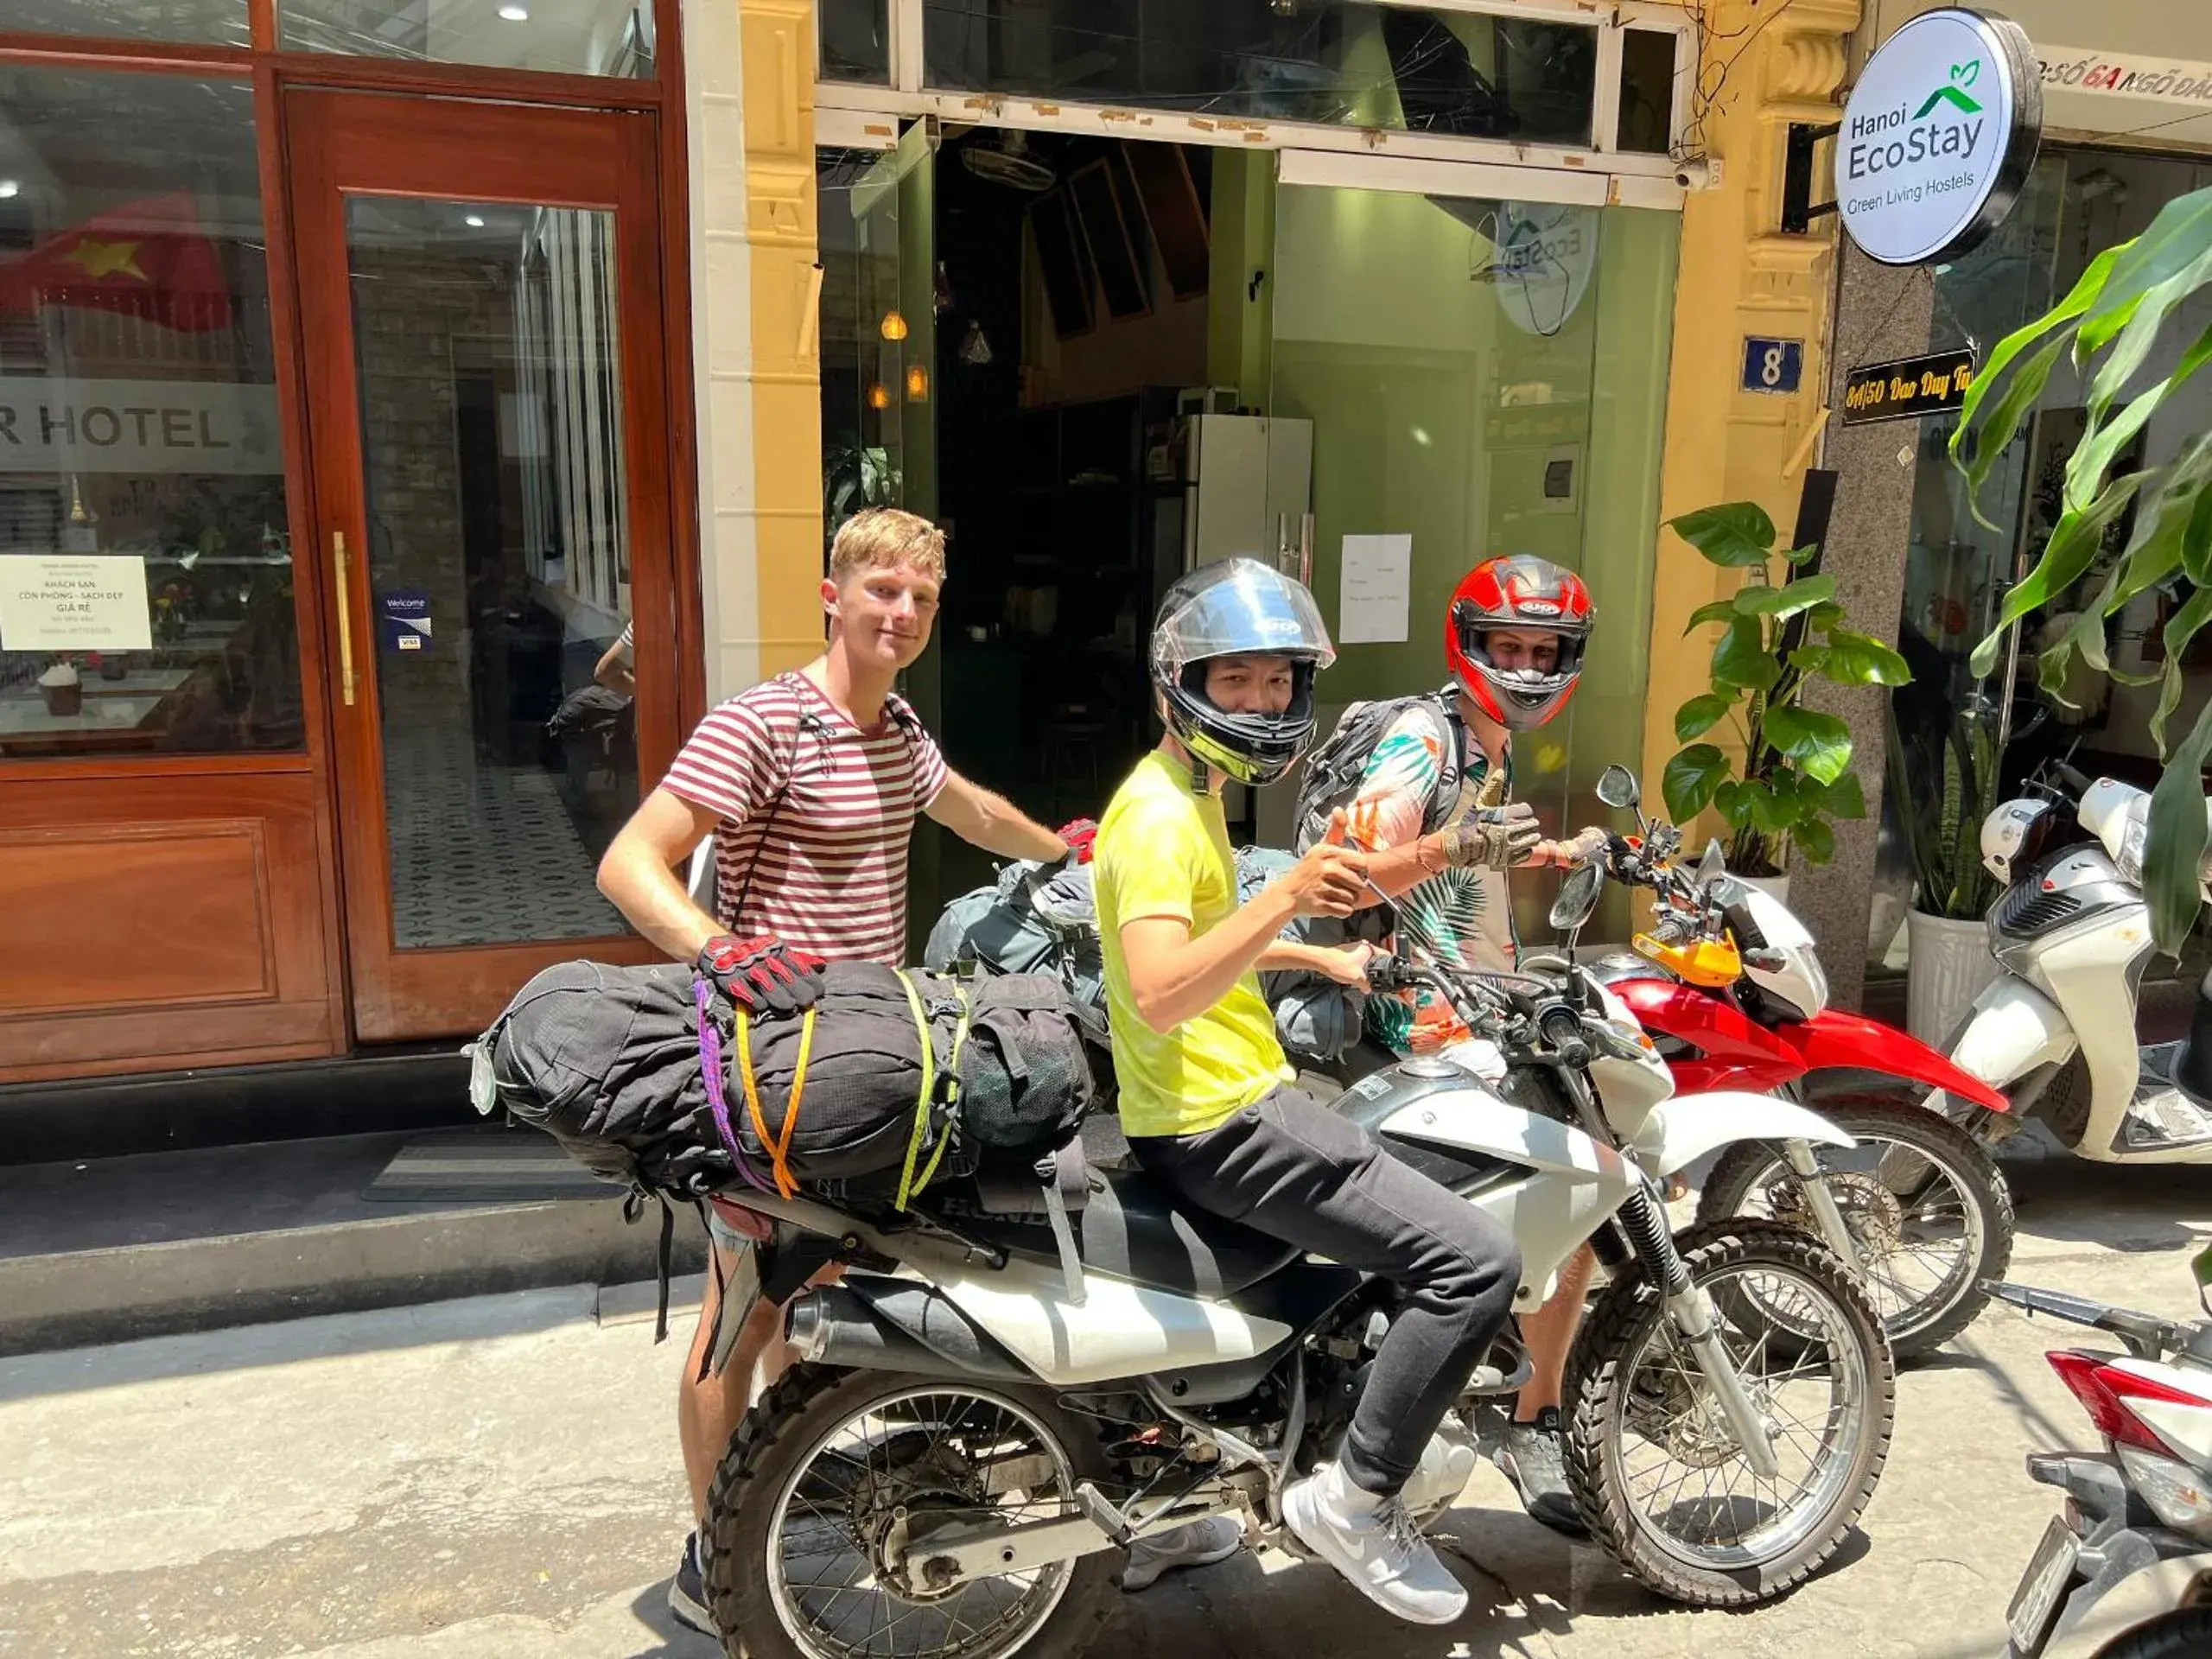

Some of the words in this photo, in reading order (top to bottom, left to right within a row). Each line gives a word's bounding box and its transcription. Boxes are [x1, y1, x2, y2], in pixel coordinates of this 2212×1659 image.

[2082, 64, 2122, 90] 6A
[1852, 102, 1907, 139] Hanoi
[1849, 118, 1984, 180] EcoStay
[1847, 196, 1883, 215] Green
[1887, 186, 1923, 205] Living
[1926, 172, 1974, 196] Hostels
[1762, 347, 1783, 385] 8
[39, 402, 231, 449] HOTEL
